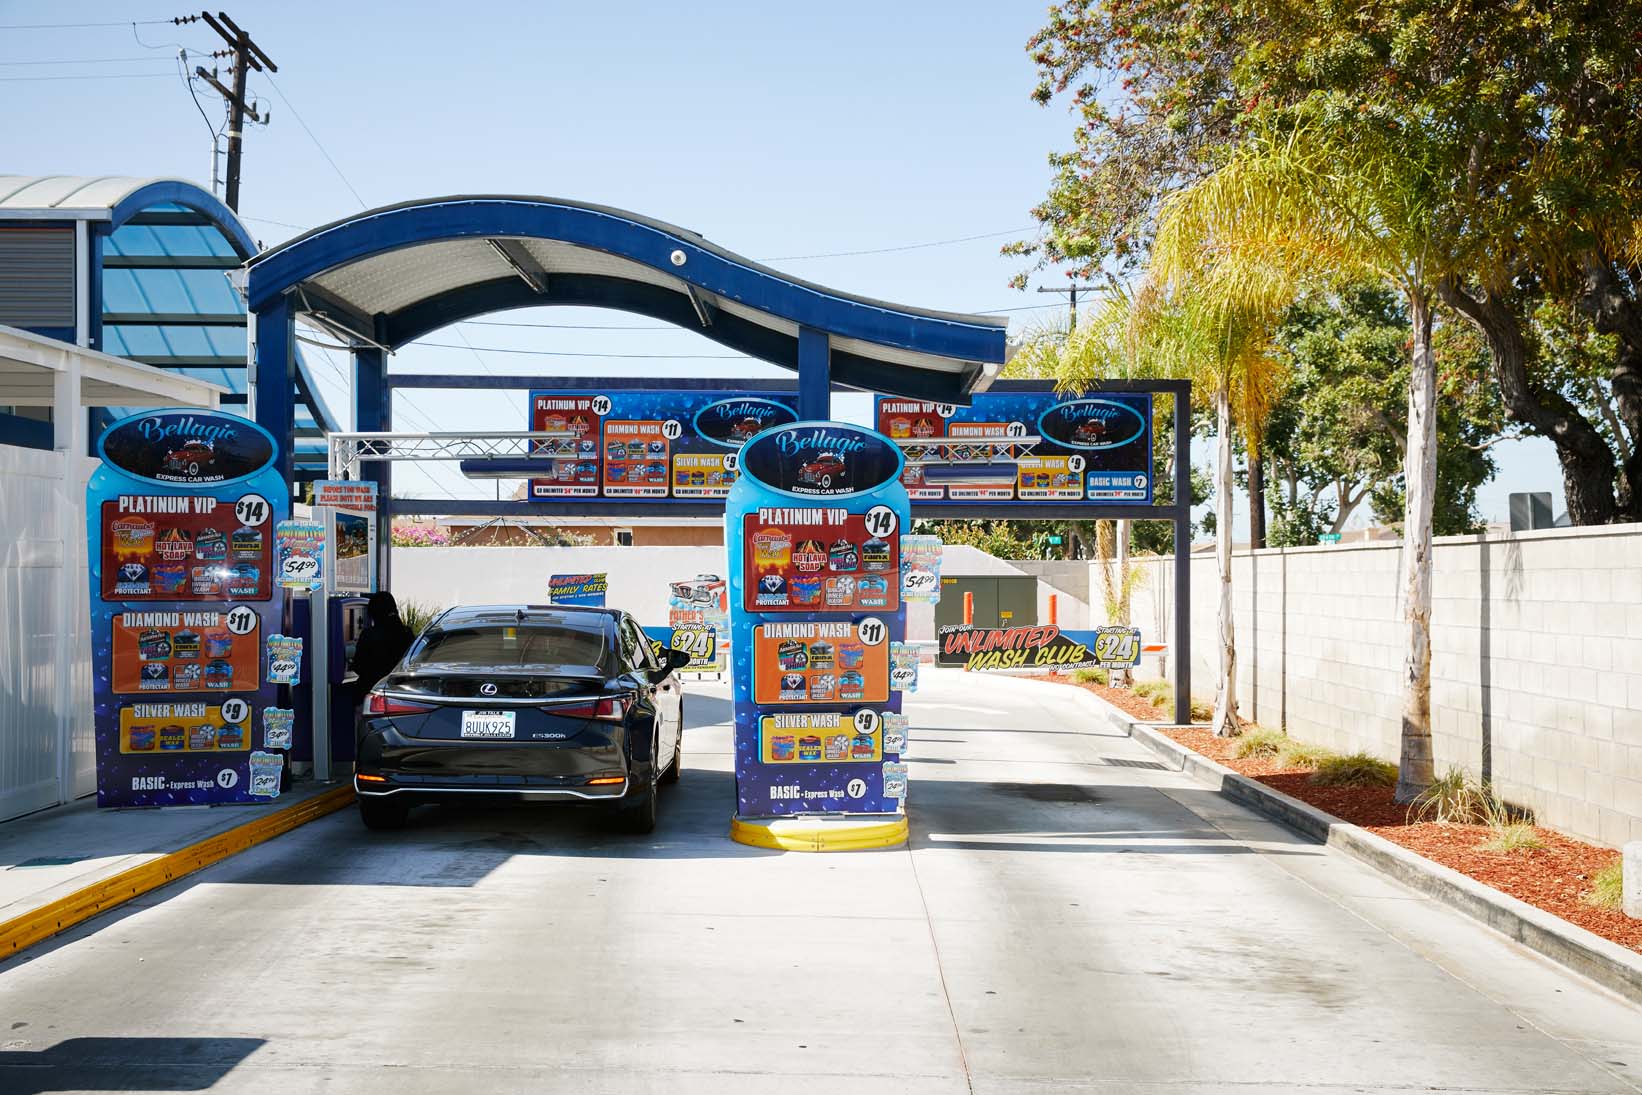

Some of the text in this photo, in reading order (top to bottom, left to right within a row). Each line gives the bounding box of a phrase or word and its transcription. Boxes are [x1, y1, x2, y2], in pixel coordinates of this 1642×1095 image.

[537, 399, 591, 410] PLATINUM VIP
[593, 399, 609, 412] $14
[882, 402, 935, 413] PLATINUM VIP
[607, 424, 660, 434] DIAMOND WASH
[951, 426, 1005, 437] DIAMOND WASH
[676, 457, 720, 467] SILVER WASH
[155, 473, 225, 483] EXPRESS CAR WASH
[1089, 476, 1132, 486] BASIC WASH
[791, 486, 820, 495] EXPRESS
[835, 486, 855, 494] WASH
[119, 495, 217, 514] PLATINUM VIP
[236, 501, 264, 522] $14
[759, 508, 848, 526] PLATINUM VIP
[866, 511, 892, 534] $14
[155, 541, 194, 551] HOT LAVA
[163, 550, 186, 560] SOAP
[792, 553, 828, 563] HOT LAVA
[799, 562, 820, 571] SOAP
[547, 582, 609, 597] FAMILY RATES
[123, 611, 219, 628] DIAMOND WASH
[229, 612, 251, 631] $11
[672, 623, 702, 631] STARTING
[763, 622, 851, 639] DIAMOND WASH
[862, 623, 882, 642] $11
[940, 623, 974, 634] JOIN OUR
[1096, 626, 1127, 634] STARTING
[945, 626, 1059, 654] UNLIMITED
[967, 644, 1087, 671] WASH CLUB
[1061, 658, 1097, 671] CONTRACT!
[1099, 661, 1134, 669] PER MONTH
[133, 703, 206, 718] SILVER WASH
[225, 703, 242, 720] $9
[465, 721, 511, 734] 8UUK925
[775, 714, 841, 729] SILVER WASH
[858, 713, 873, 730] $9
[132, 776, 215, 791] BASIC Express Wash
[221, 772, 233, 786] $7
[769, 785, 845, 800] BASIC Express Wash
[850, 783, 861, 797] $7
